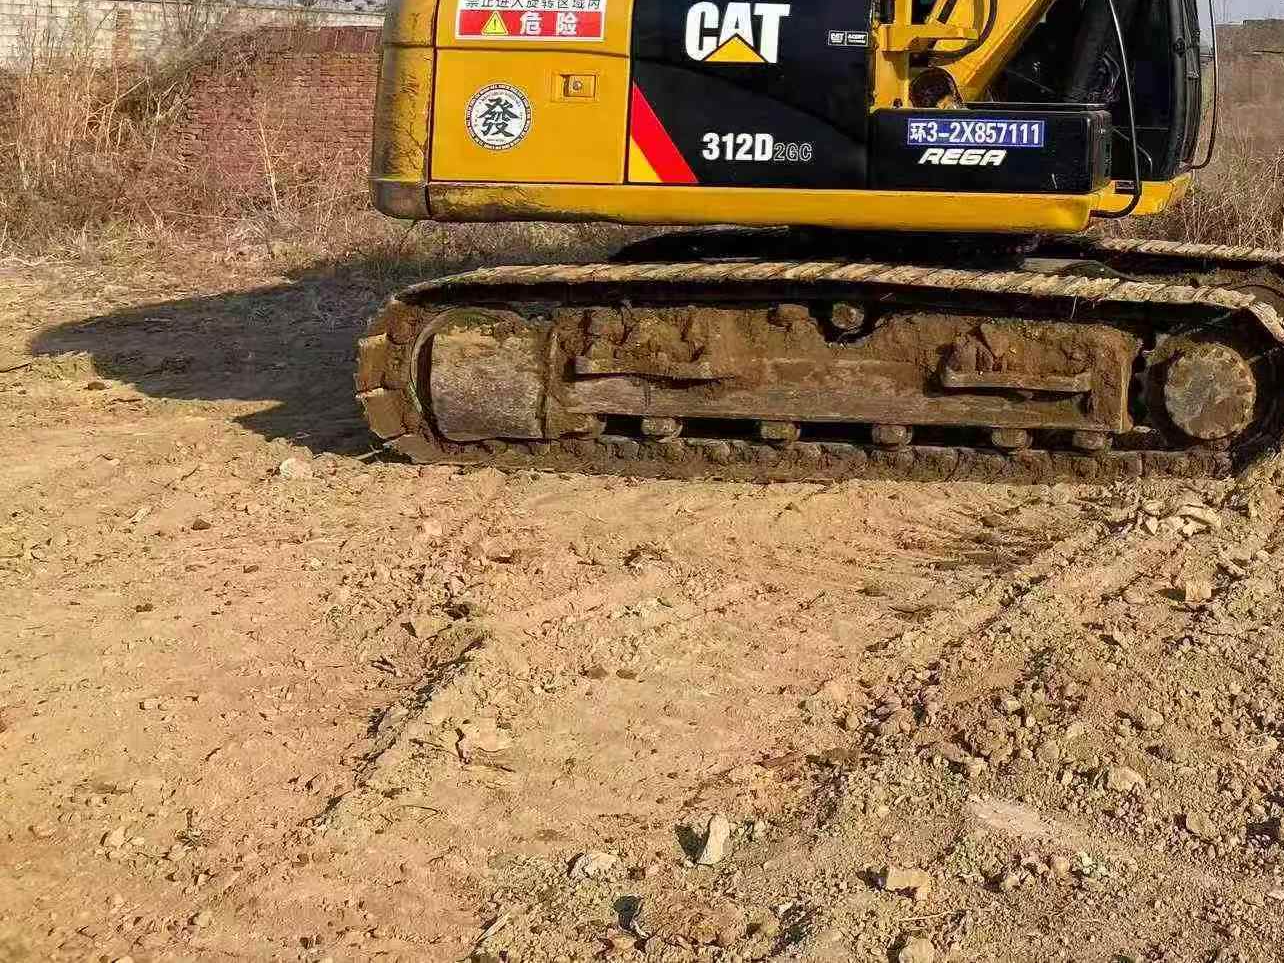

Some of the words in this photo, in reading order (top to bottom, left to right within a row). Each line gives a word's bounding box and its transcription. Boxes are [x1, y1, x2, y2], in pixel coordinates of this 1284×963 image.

[686, 2, 790, 63] CAT
[478, 97, 518, 137] 發
[910, 121, 1040, 144] 环3-2X857111
